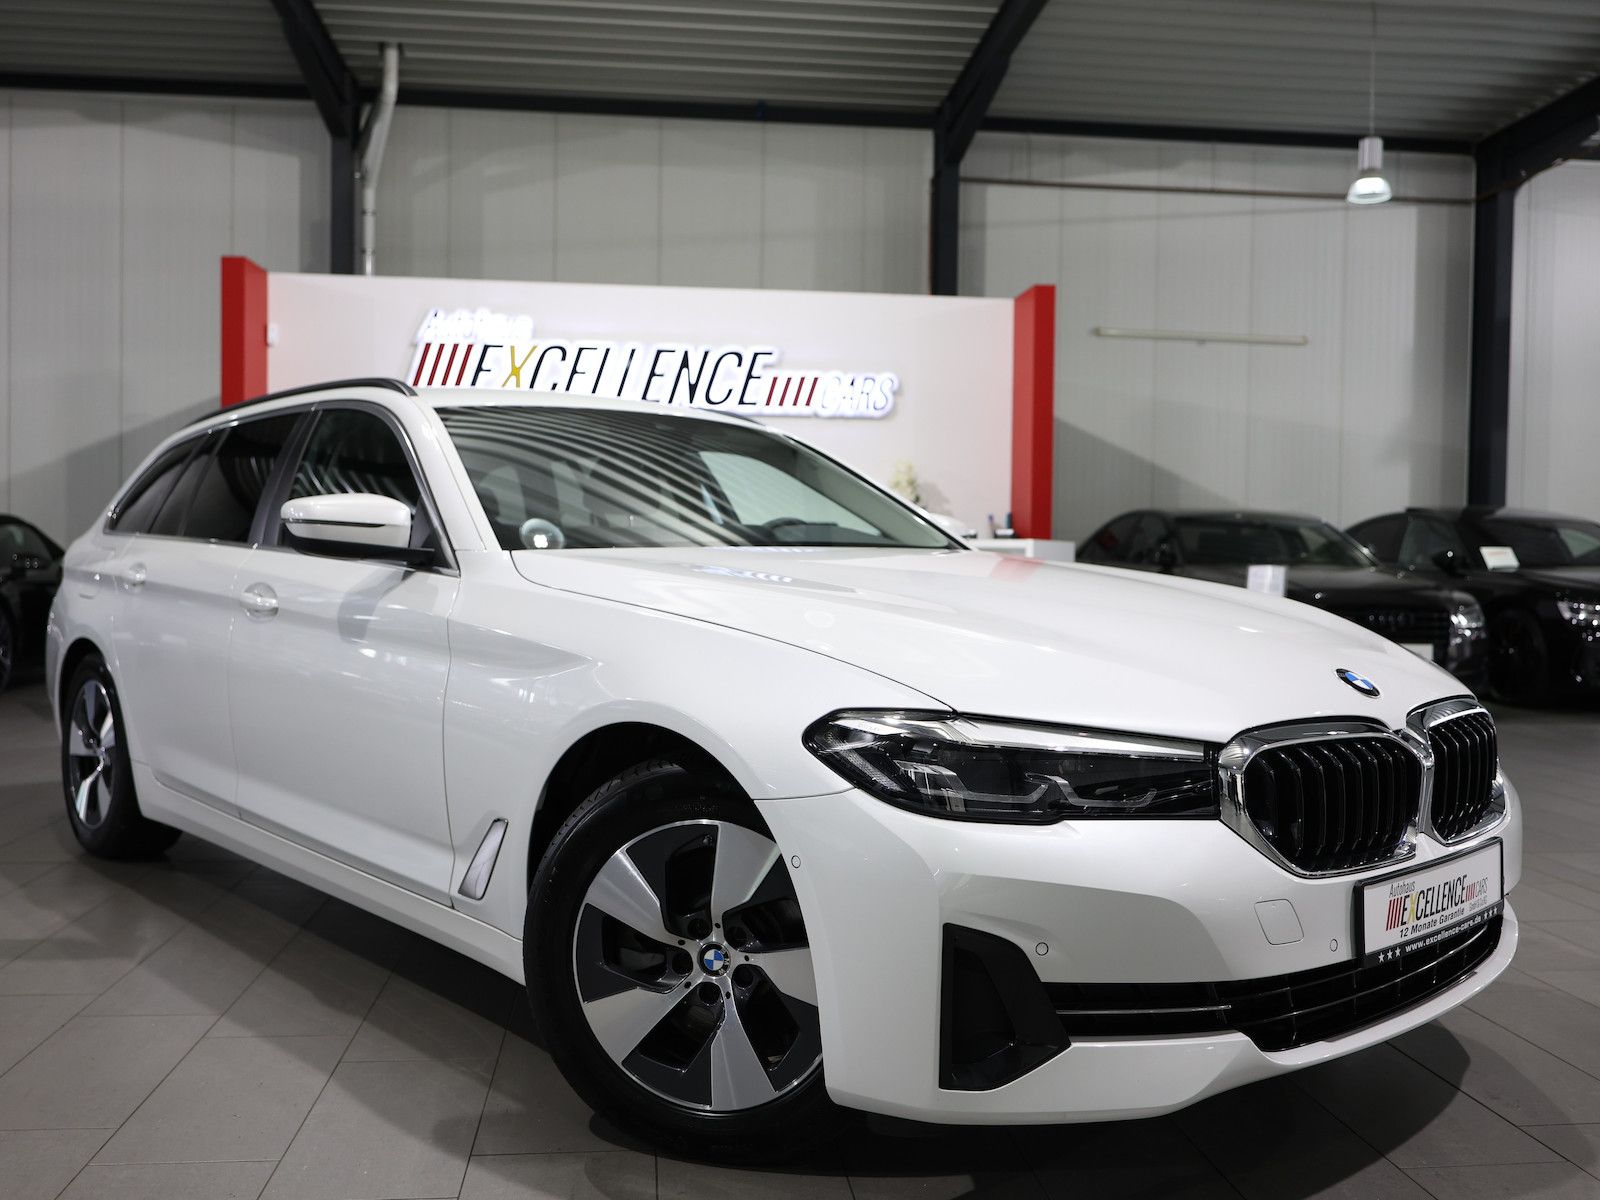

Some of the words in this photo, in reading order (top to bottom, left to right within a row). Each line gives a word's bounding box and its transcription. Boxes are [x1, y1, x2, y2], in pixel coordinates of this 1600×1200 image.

[820, 375, 895, 412] CARS
[1389, 881, 1416, 898] Autohaus
[1400, 874, 1468, 926] EXCELLENCE
[1399, 927, 1409, 939] 12
[1410, 918, 1438, 935] Monate
[1439, 906, 1465, 925] Garantie
